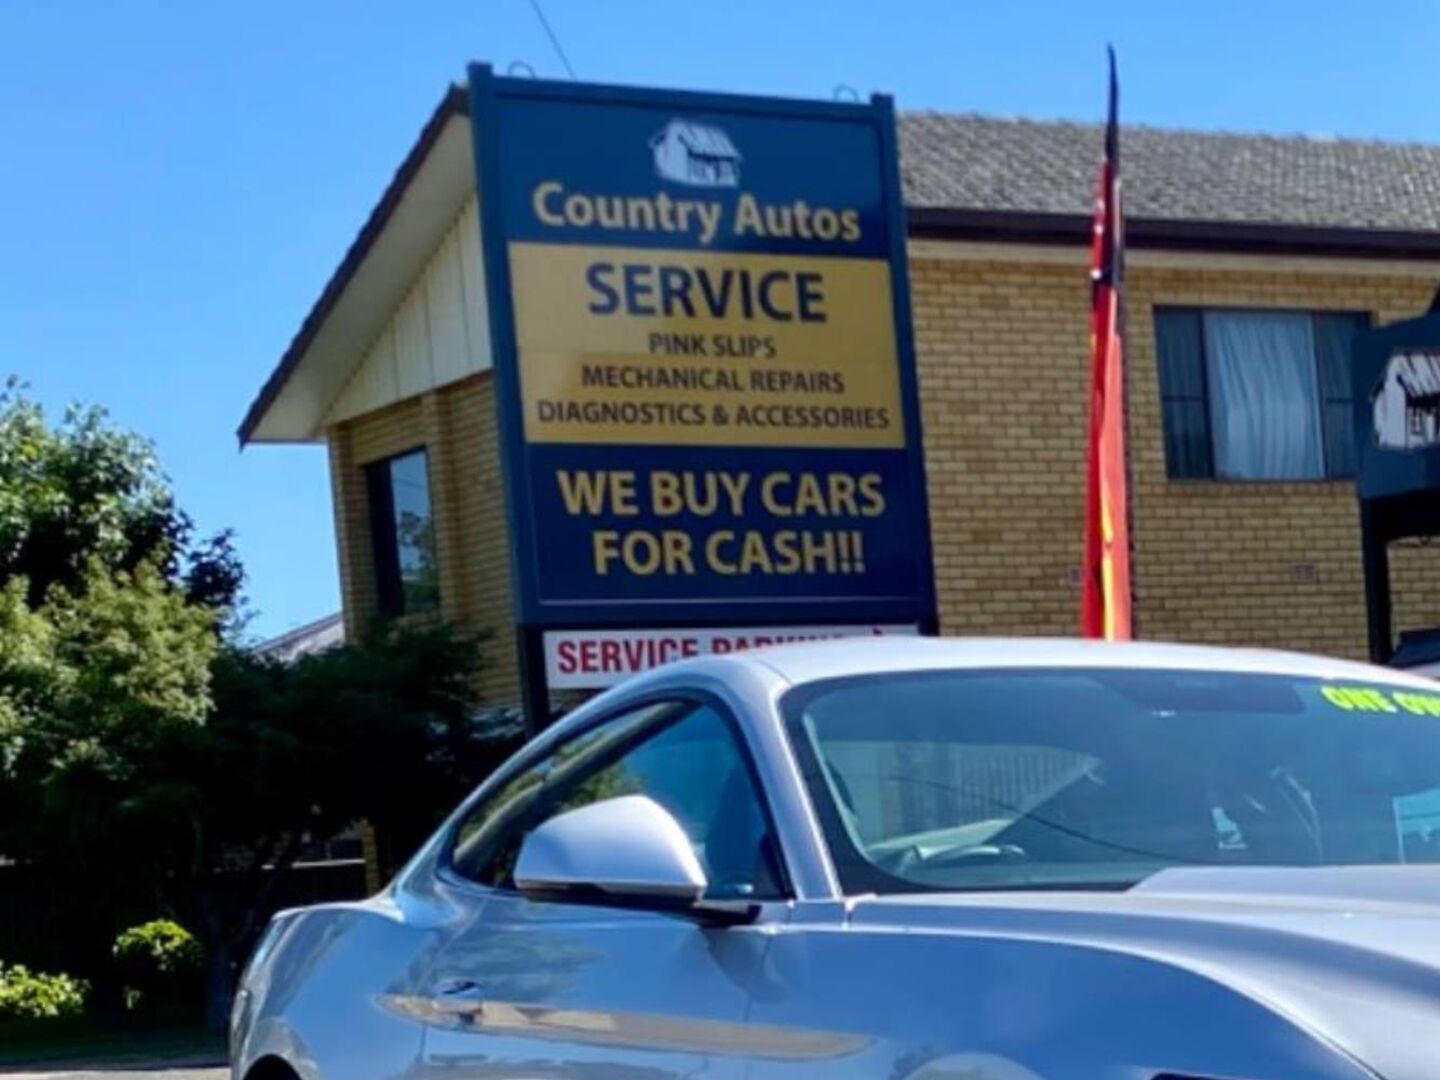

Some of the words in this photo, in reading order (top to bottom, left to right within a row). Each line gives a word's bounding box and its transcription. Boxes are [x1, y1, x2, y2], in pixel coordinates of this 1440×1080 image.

[533, 181, 721, 243] Country
[734, 194, 861, 241] Autos
[586, 263, 827, 323] SERVICE
[649, 333, 706, 356] PINK
[712, 334, 776, 358] SLIPS
[582, 365, 744, 391] MECHANICAL
[750, 368, 845, 394] REPAIRS
[538, 400, 707, 426] DIAGNOSTICS
[712, 405, 729, 427] &
[736, 403, 890, 429] ACCESSORIES
[556, 469, 639, 516] WE
[650, 471, 752, 517] BUY
[761, 472, 886, 517] CARS
[593, 530, 696, 575] FOR
[705, 531, 865, 575] CASH!!
[557, 637, 700, 675] SERVICE
